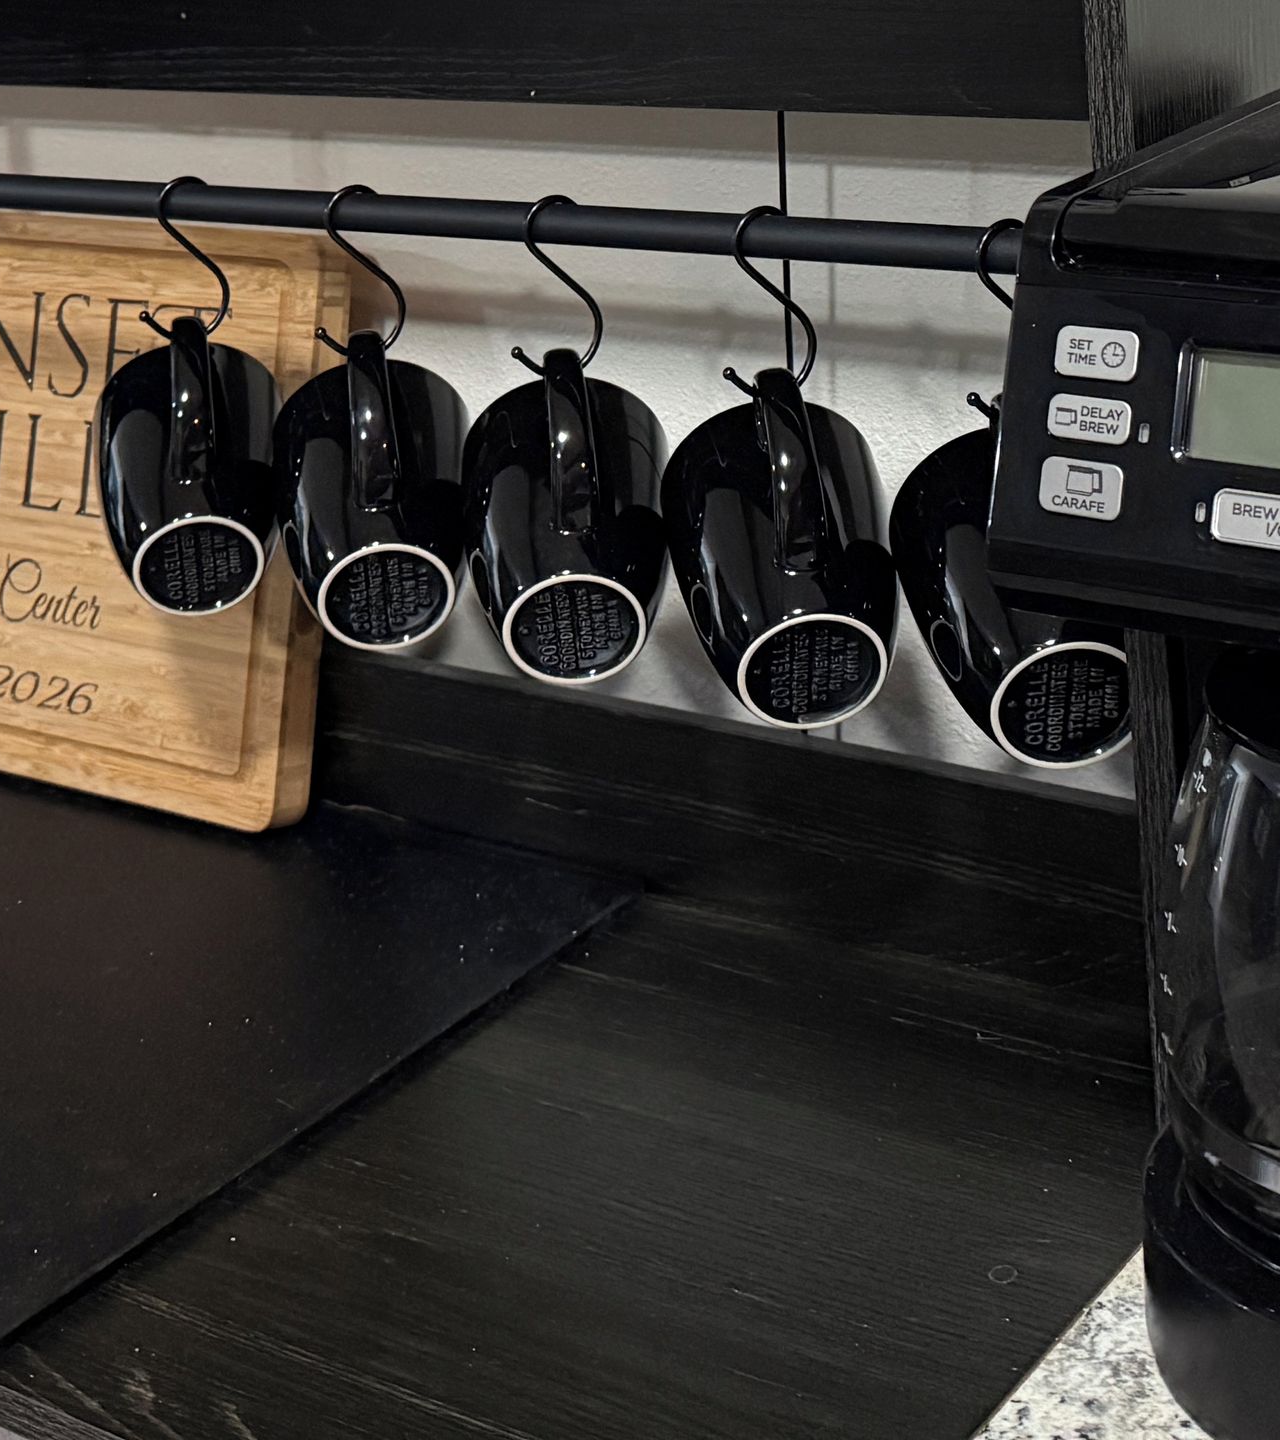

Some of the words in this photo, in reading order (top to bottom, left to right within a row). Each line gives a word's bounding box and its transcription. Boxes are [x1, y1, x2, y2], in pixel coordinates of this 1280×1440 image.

[1069, 338, 1094, 351] SET
[1067, 352, 1097, 366] TIME
[1080, 405, 1124, 421] DELAY
[1079, 420, 1119, 435] BREW
[1051, 494, 1106, 514] CARAFE
[1232, 502, 1280, 521] BREW
[163, 533, 184, 601] CORELLE
[535, 591, 559, 666] CORELLE
[1089, 667, 1104, 682] IN
[1024, 662, 1048, 745] CORELLE
[1068, 659, 1088, 739] STONEWARE
[1103, 675, 1120, 719] CHINA
[1086, 688, 1103, 728] MADE
